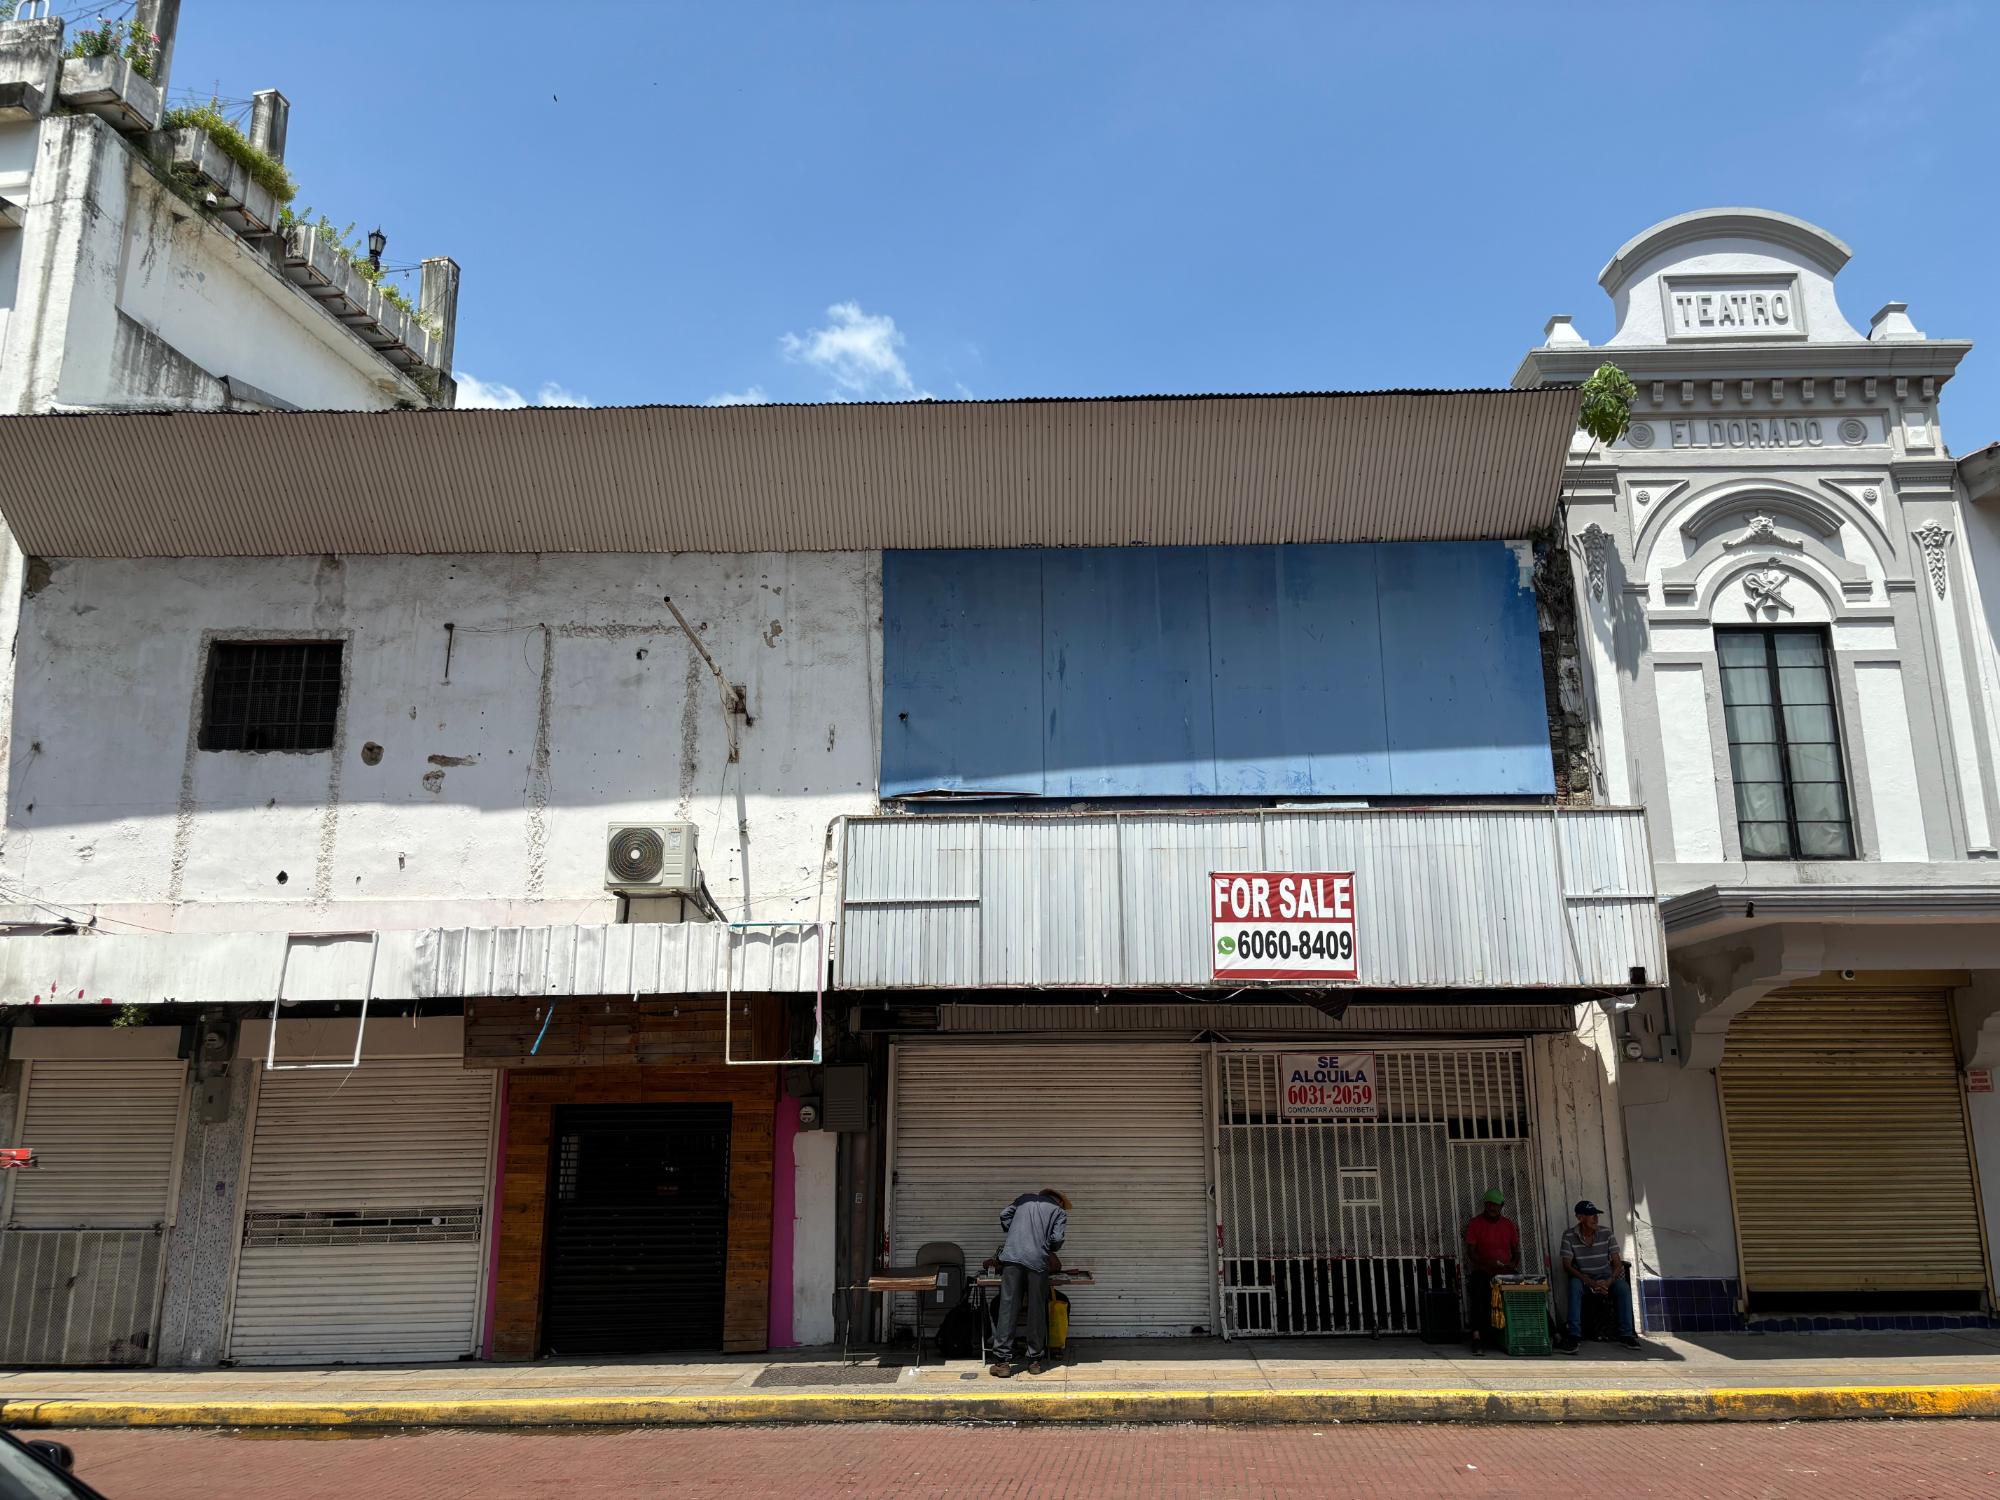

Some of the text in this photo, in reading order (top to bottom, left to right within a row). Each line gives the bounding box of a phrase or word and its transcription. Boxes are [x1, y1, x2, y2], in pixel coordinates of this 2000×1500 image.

[1676, 293, 1789, 326] TEATRO
[1215, 878, 1352, 918] FOR SALE
[1238, 930, 1352, 960] 6060-8409
[1318, 1056, 1339, 1069] SE
[1291, 1070, 1367, 1083] ALQUILA
[1288, 1085, 1372, 1105] 6031-2059
[1287, 1106, 1328, 1114] CONTACTAR
[1335, 1106, 1375, 1114] GLORYBETH
